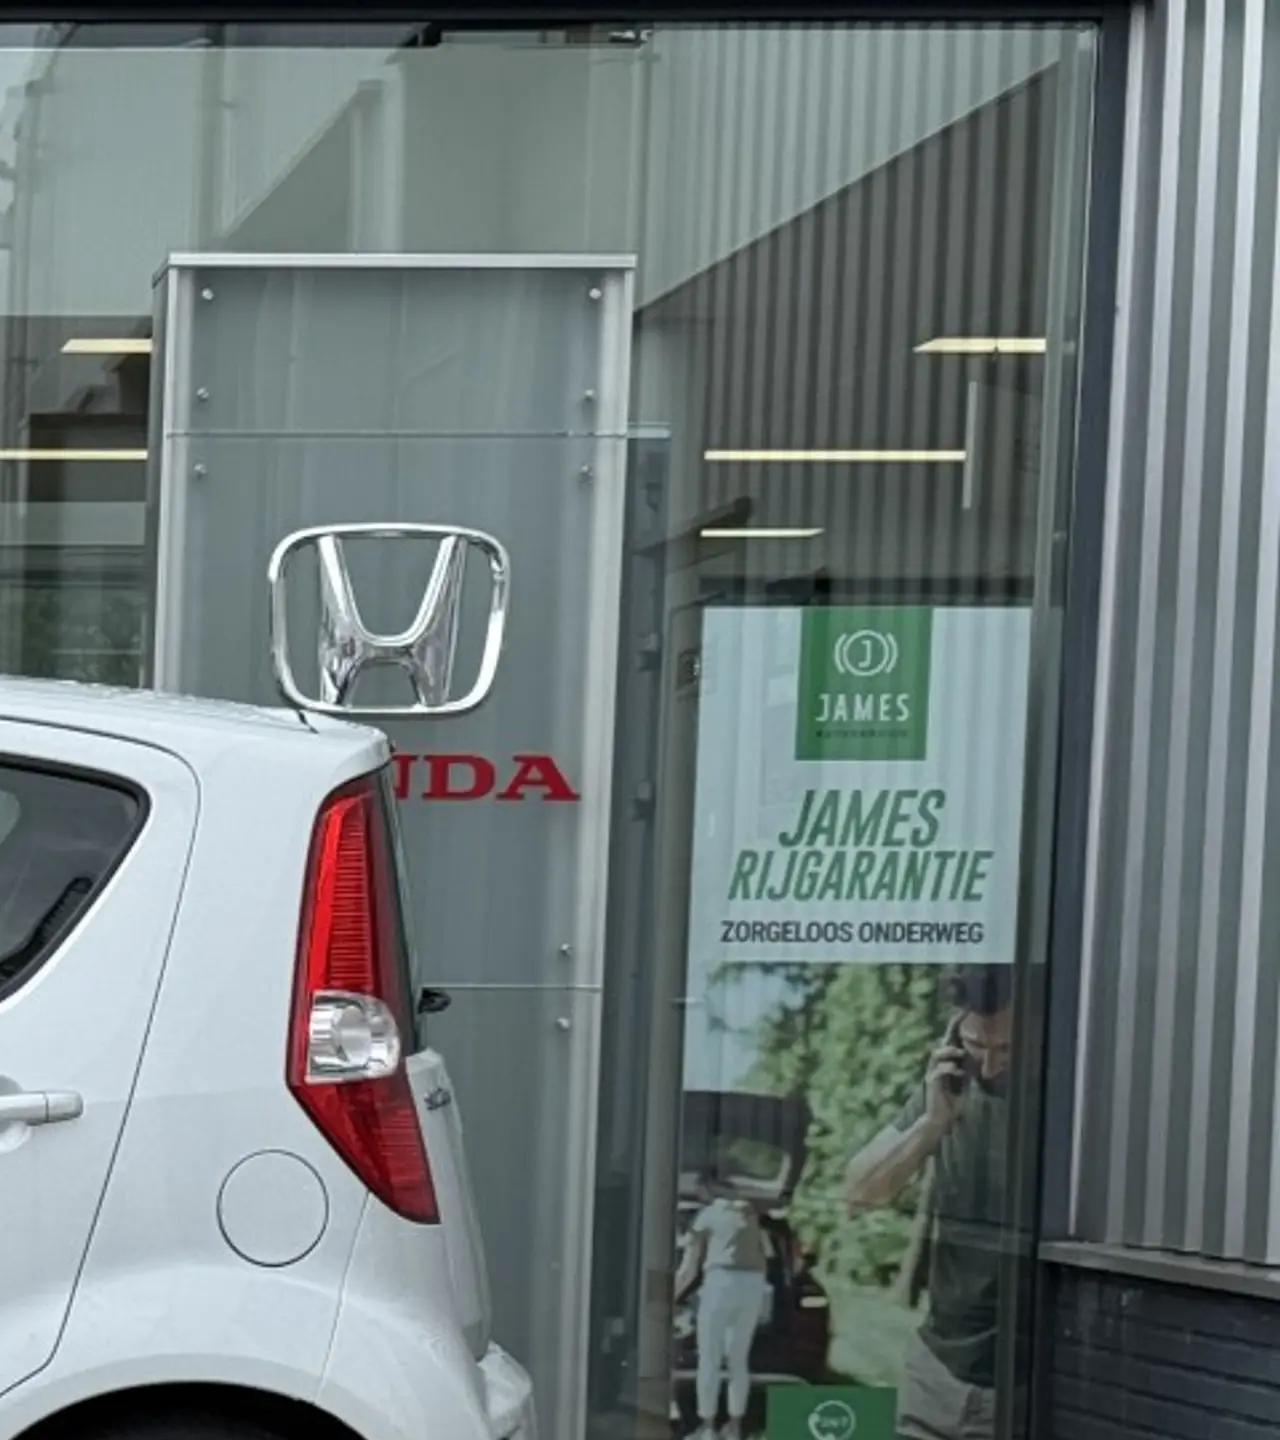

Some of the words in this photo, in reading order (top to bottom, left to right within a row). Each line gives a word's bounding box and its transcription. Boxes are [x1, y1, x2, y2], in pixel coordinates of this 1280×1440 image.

[815, 693, 910, 722] JAMES
[778, 790, 947, 848] JAMES
[728, 850, 995, 902] RIJGARANTIE
[721, 920, 853, 944] ZORGELOOS
[859, 920, 984, 944] ONDERWEG
